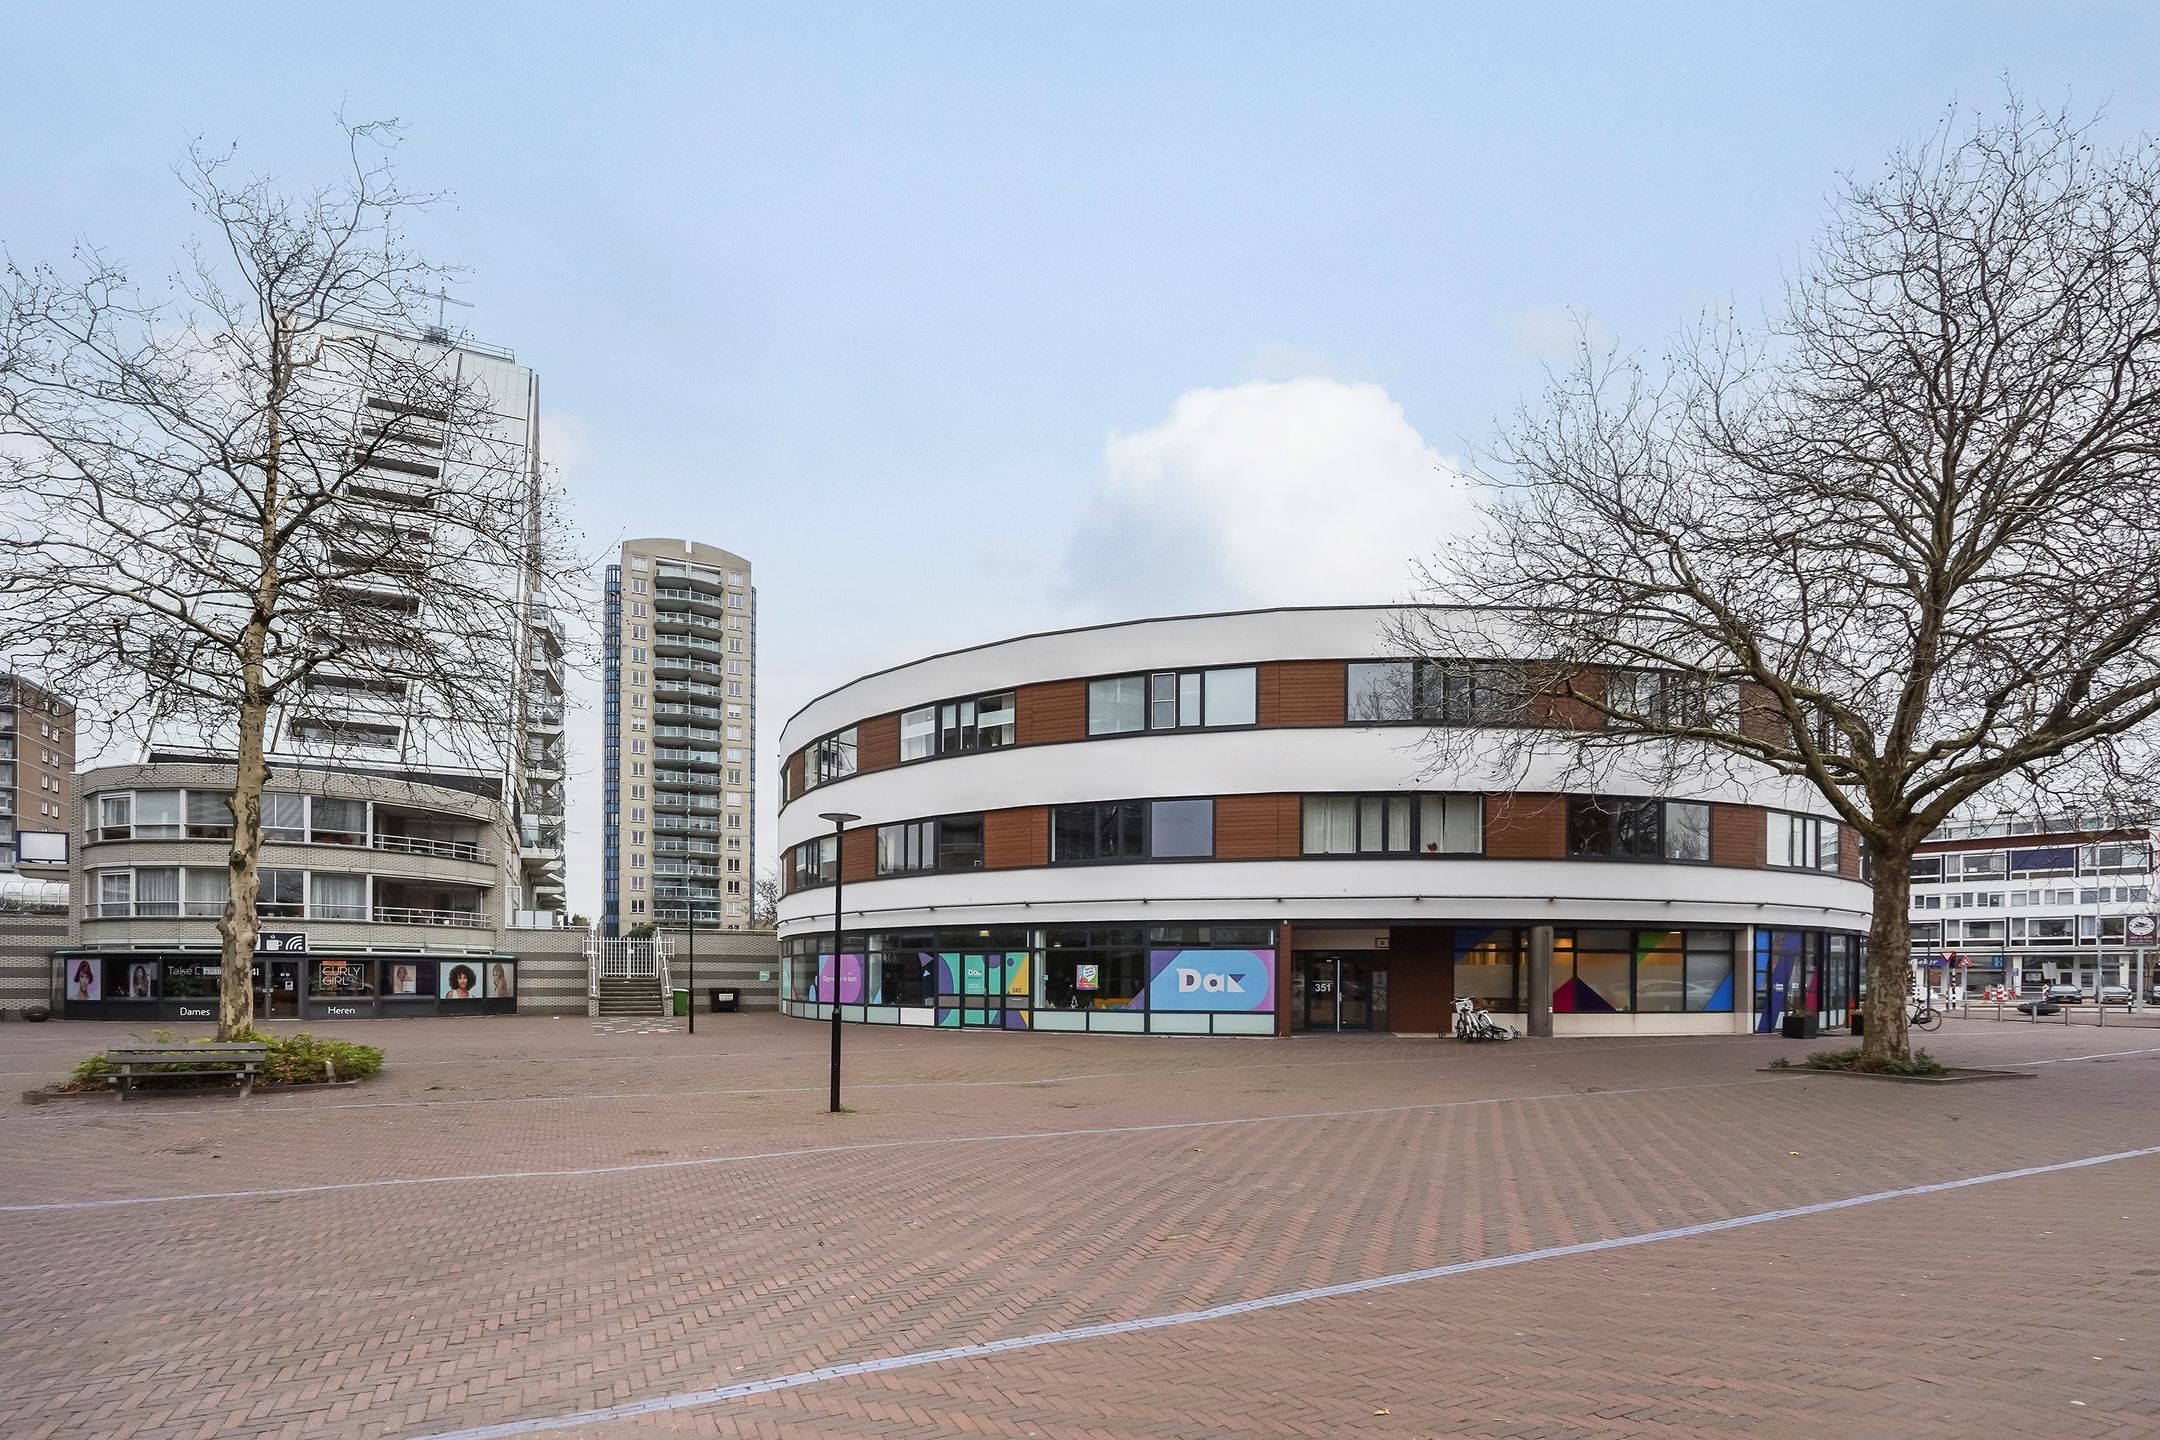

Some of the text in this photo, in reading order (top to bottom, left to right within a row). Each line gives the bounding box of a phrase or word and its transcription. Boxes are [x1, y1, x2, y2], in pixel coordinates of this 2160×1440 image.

[168, 966, 193, 976] Take
[322, 966, 361, 976] CURLY
[322, 976, 349, 986] GIRL
[1314, 983, 1331, 992] 351
[179, 1006, 211, 1016] Dames
[327, 1006, 356, 1015] Heren
